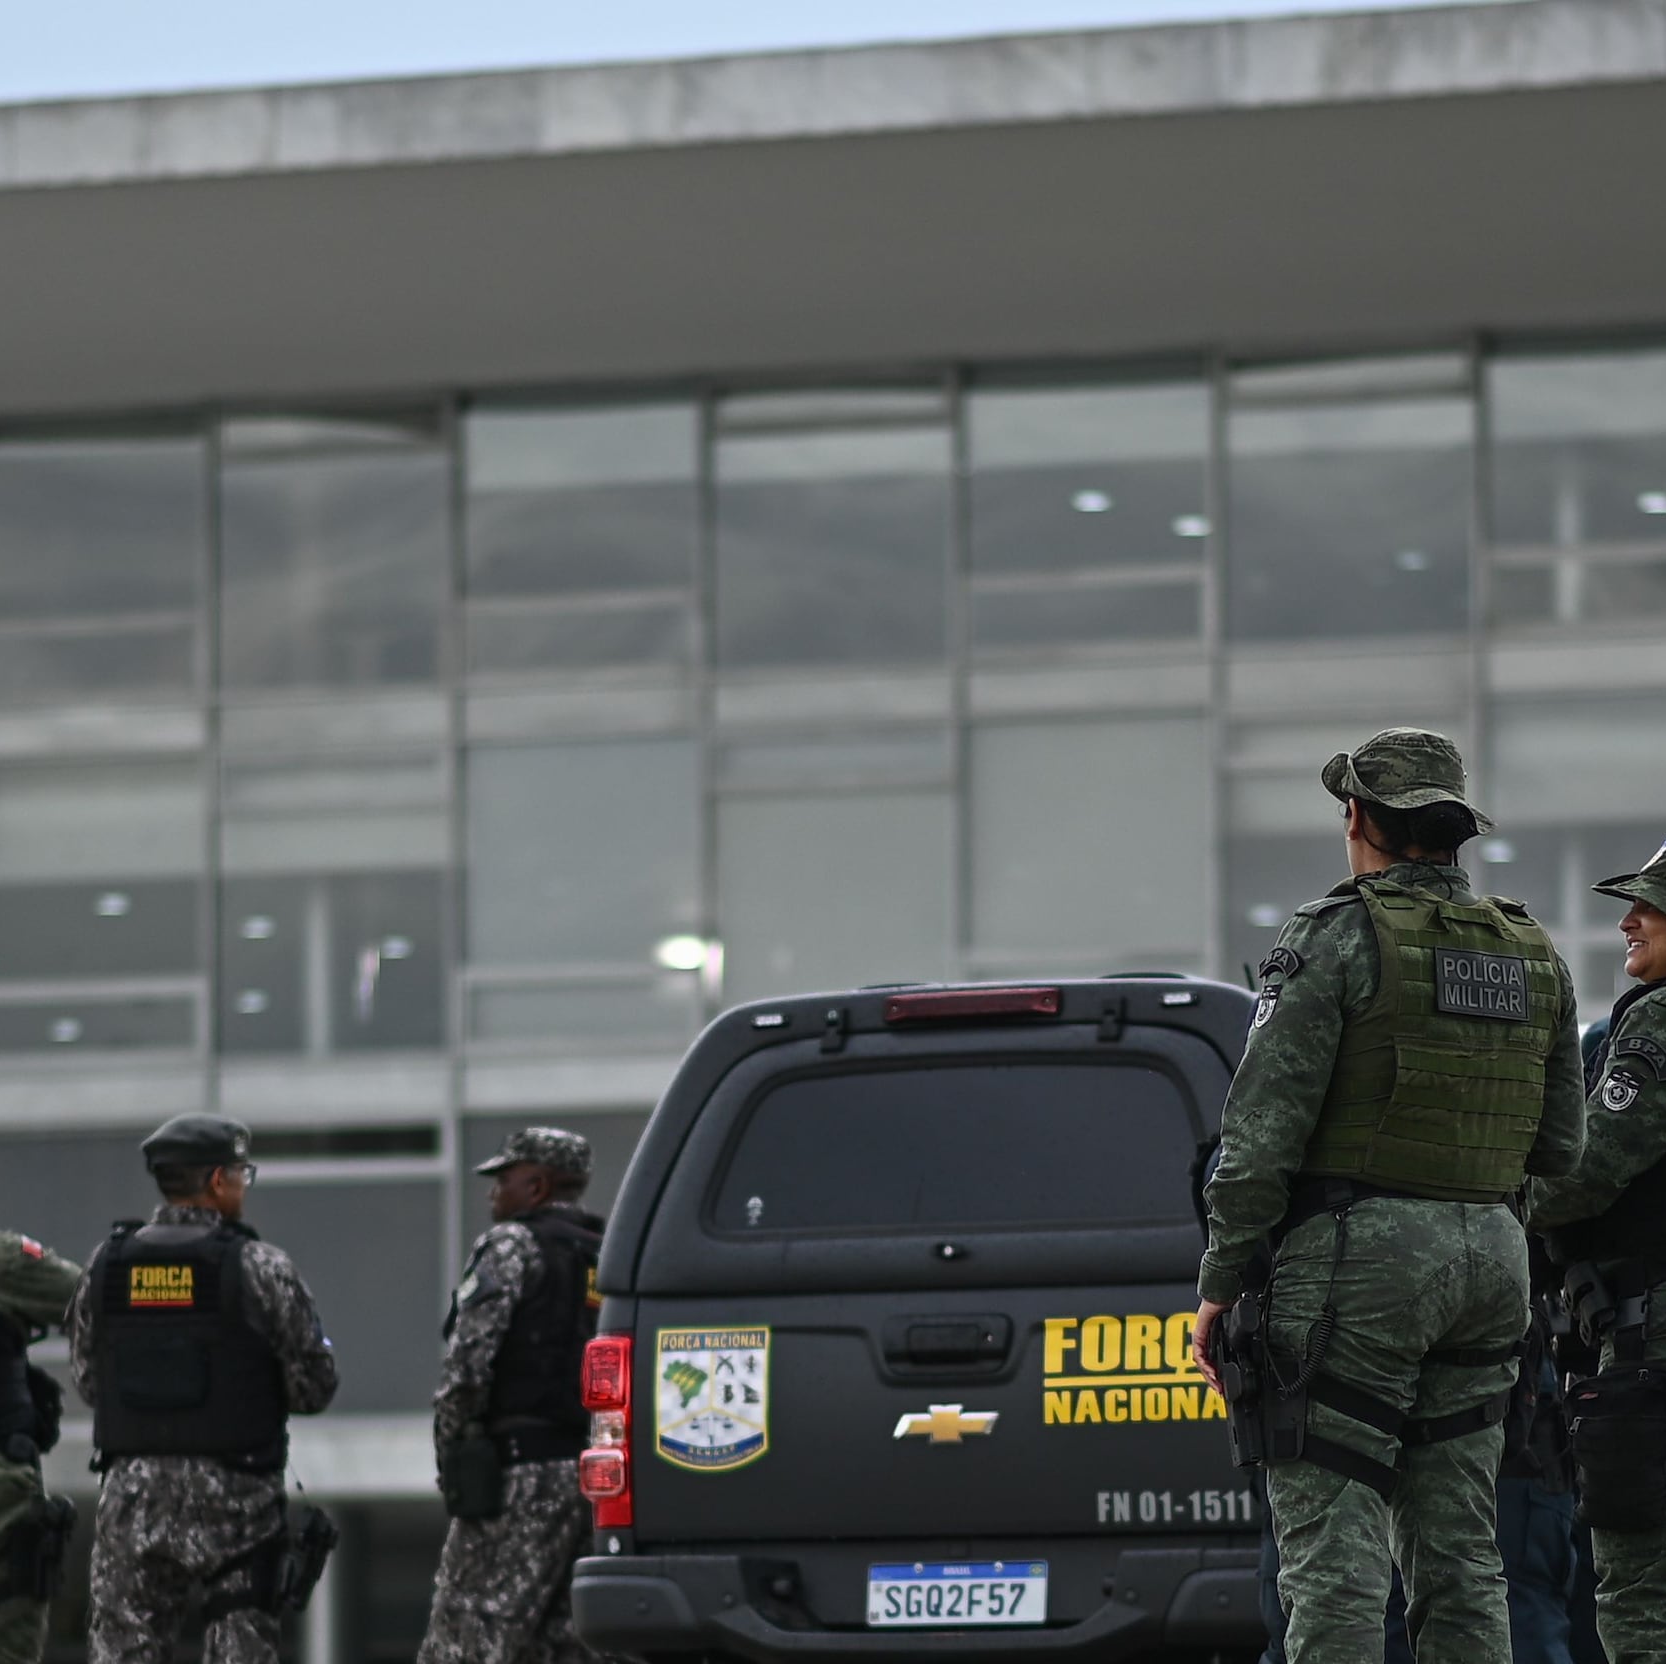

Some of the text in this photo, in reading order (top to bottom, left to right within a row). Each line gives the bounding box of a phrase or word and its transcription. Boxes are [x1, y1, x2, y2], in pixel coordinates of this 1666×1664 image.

[1443, 956, 1522, 986] POLÍCIA
[1444, 983, 1523, 1013] MILITAR
[1628, 1038, 1665, 1067] BPA
[705, 1333, 763, 1348] NACIONAL
[1044, 1312, 1199, 1376] FORÇ
[1044, 1387, 1228, 1424] NACIONA
[1097, 1490, 1251, 1523] FN 01-1511
[884, 1583, 1026, 1618] SGQ2F57
